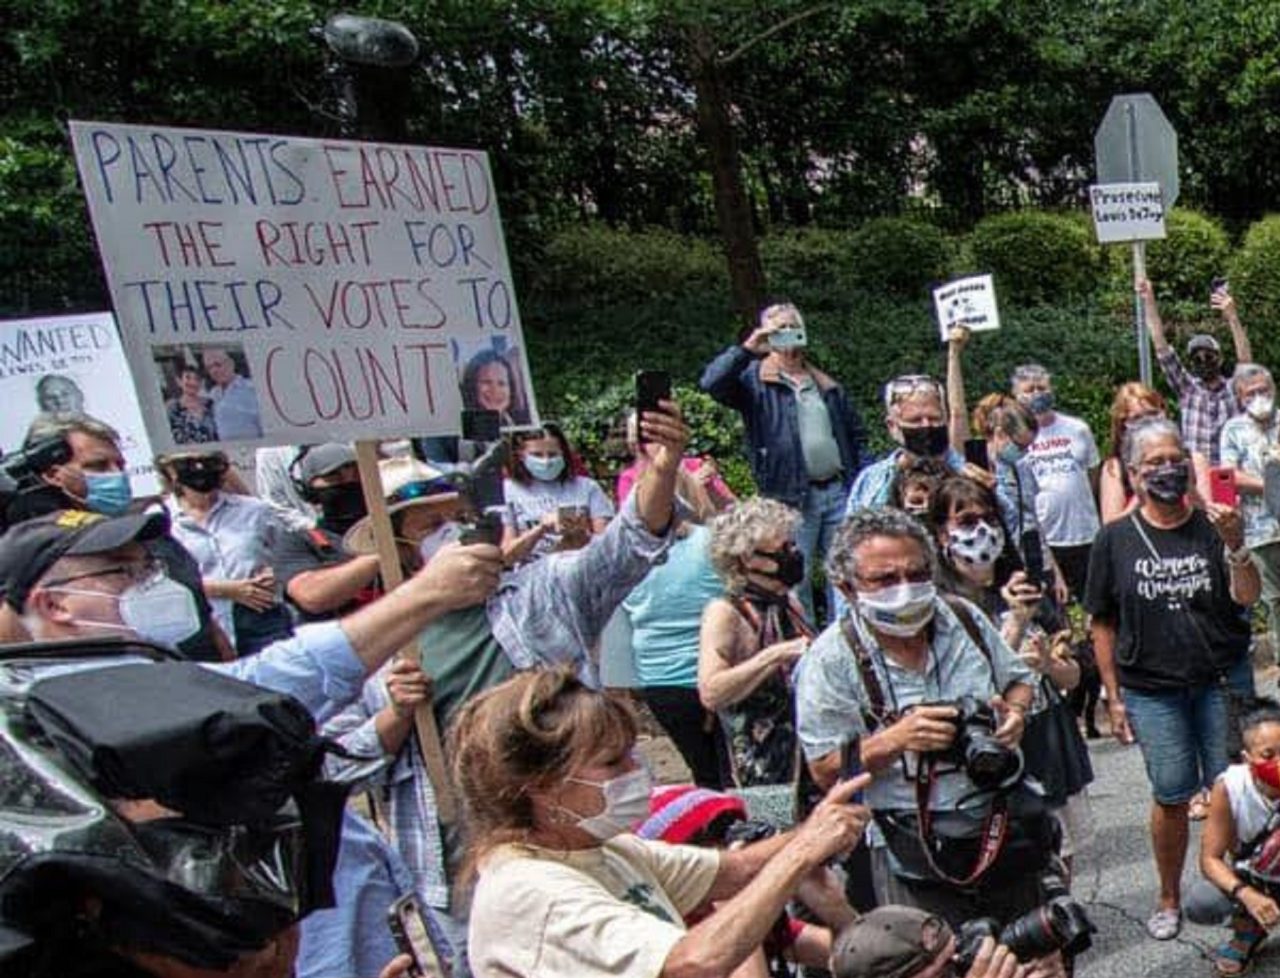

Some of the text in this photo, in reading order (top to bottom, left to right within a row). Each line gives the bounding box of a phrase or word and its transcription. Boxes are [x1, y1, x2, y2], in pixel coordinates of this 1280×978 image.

[324, 145, 490, 215] EARNED
[143, 218, 493, 270] THE RIGHT FOR
[124, 275, 511, 333] THEIR VOTES TO
